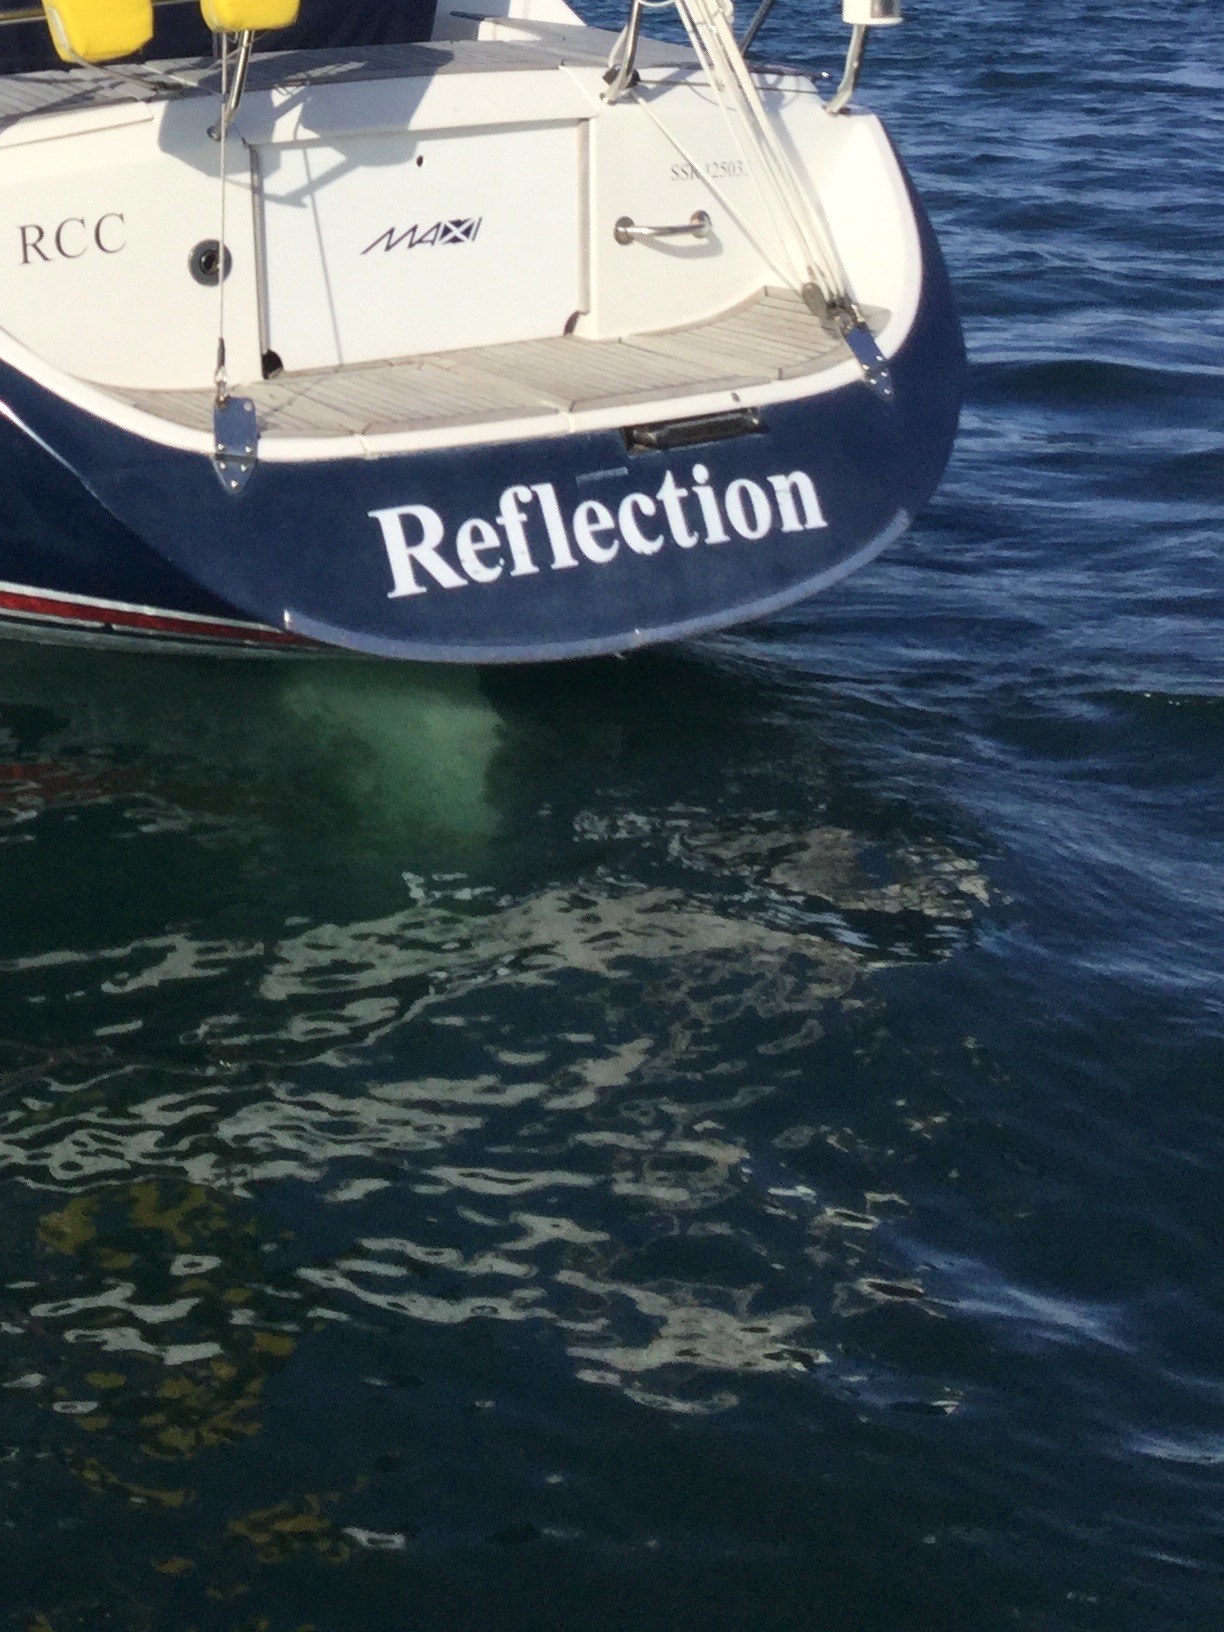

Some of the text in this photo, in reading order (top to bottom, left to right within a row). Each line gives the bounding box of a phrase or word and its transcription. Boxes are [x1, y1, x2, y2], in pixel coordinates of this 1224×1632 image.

[16, 212, 127, 265] RCC
[360, 216, 484, 255] MAXI
[368, 463, 828, 599] Reflection
